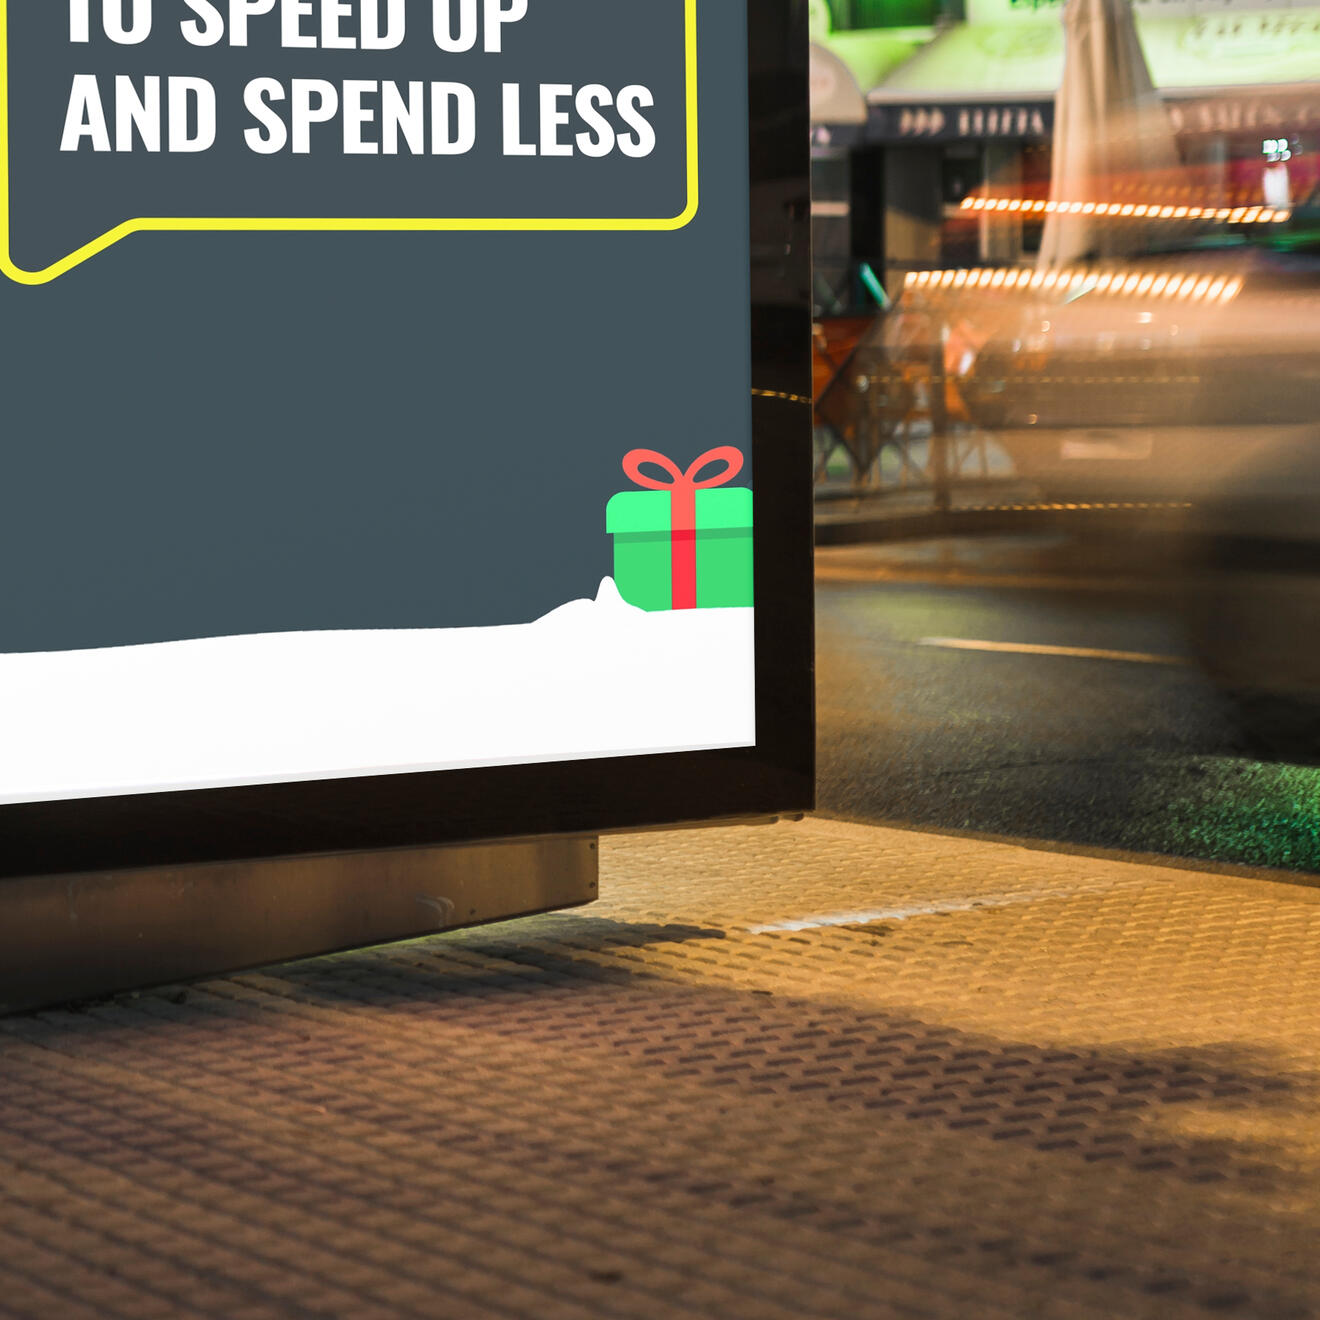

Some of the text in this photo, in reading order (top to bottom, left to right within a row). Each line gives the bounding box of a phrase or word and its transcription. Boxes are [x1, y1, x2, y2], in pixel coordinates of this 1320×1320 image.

[59, 73, 656, 158] AND SPEND LESS
